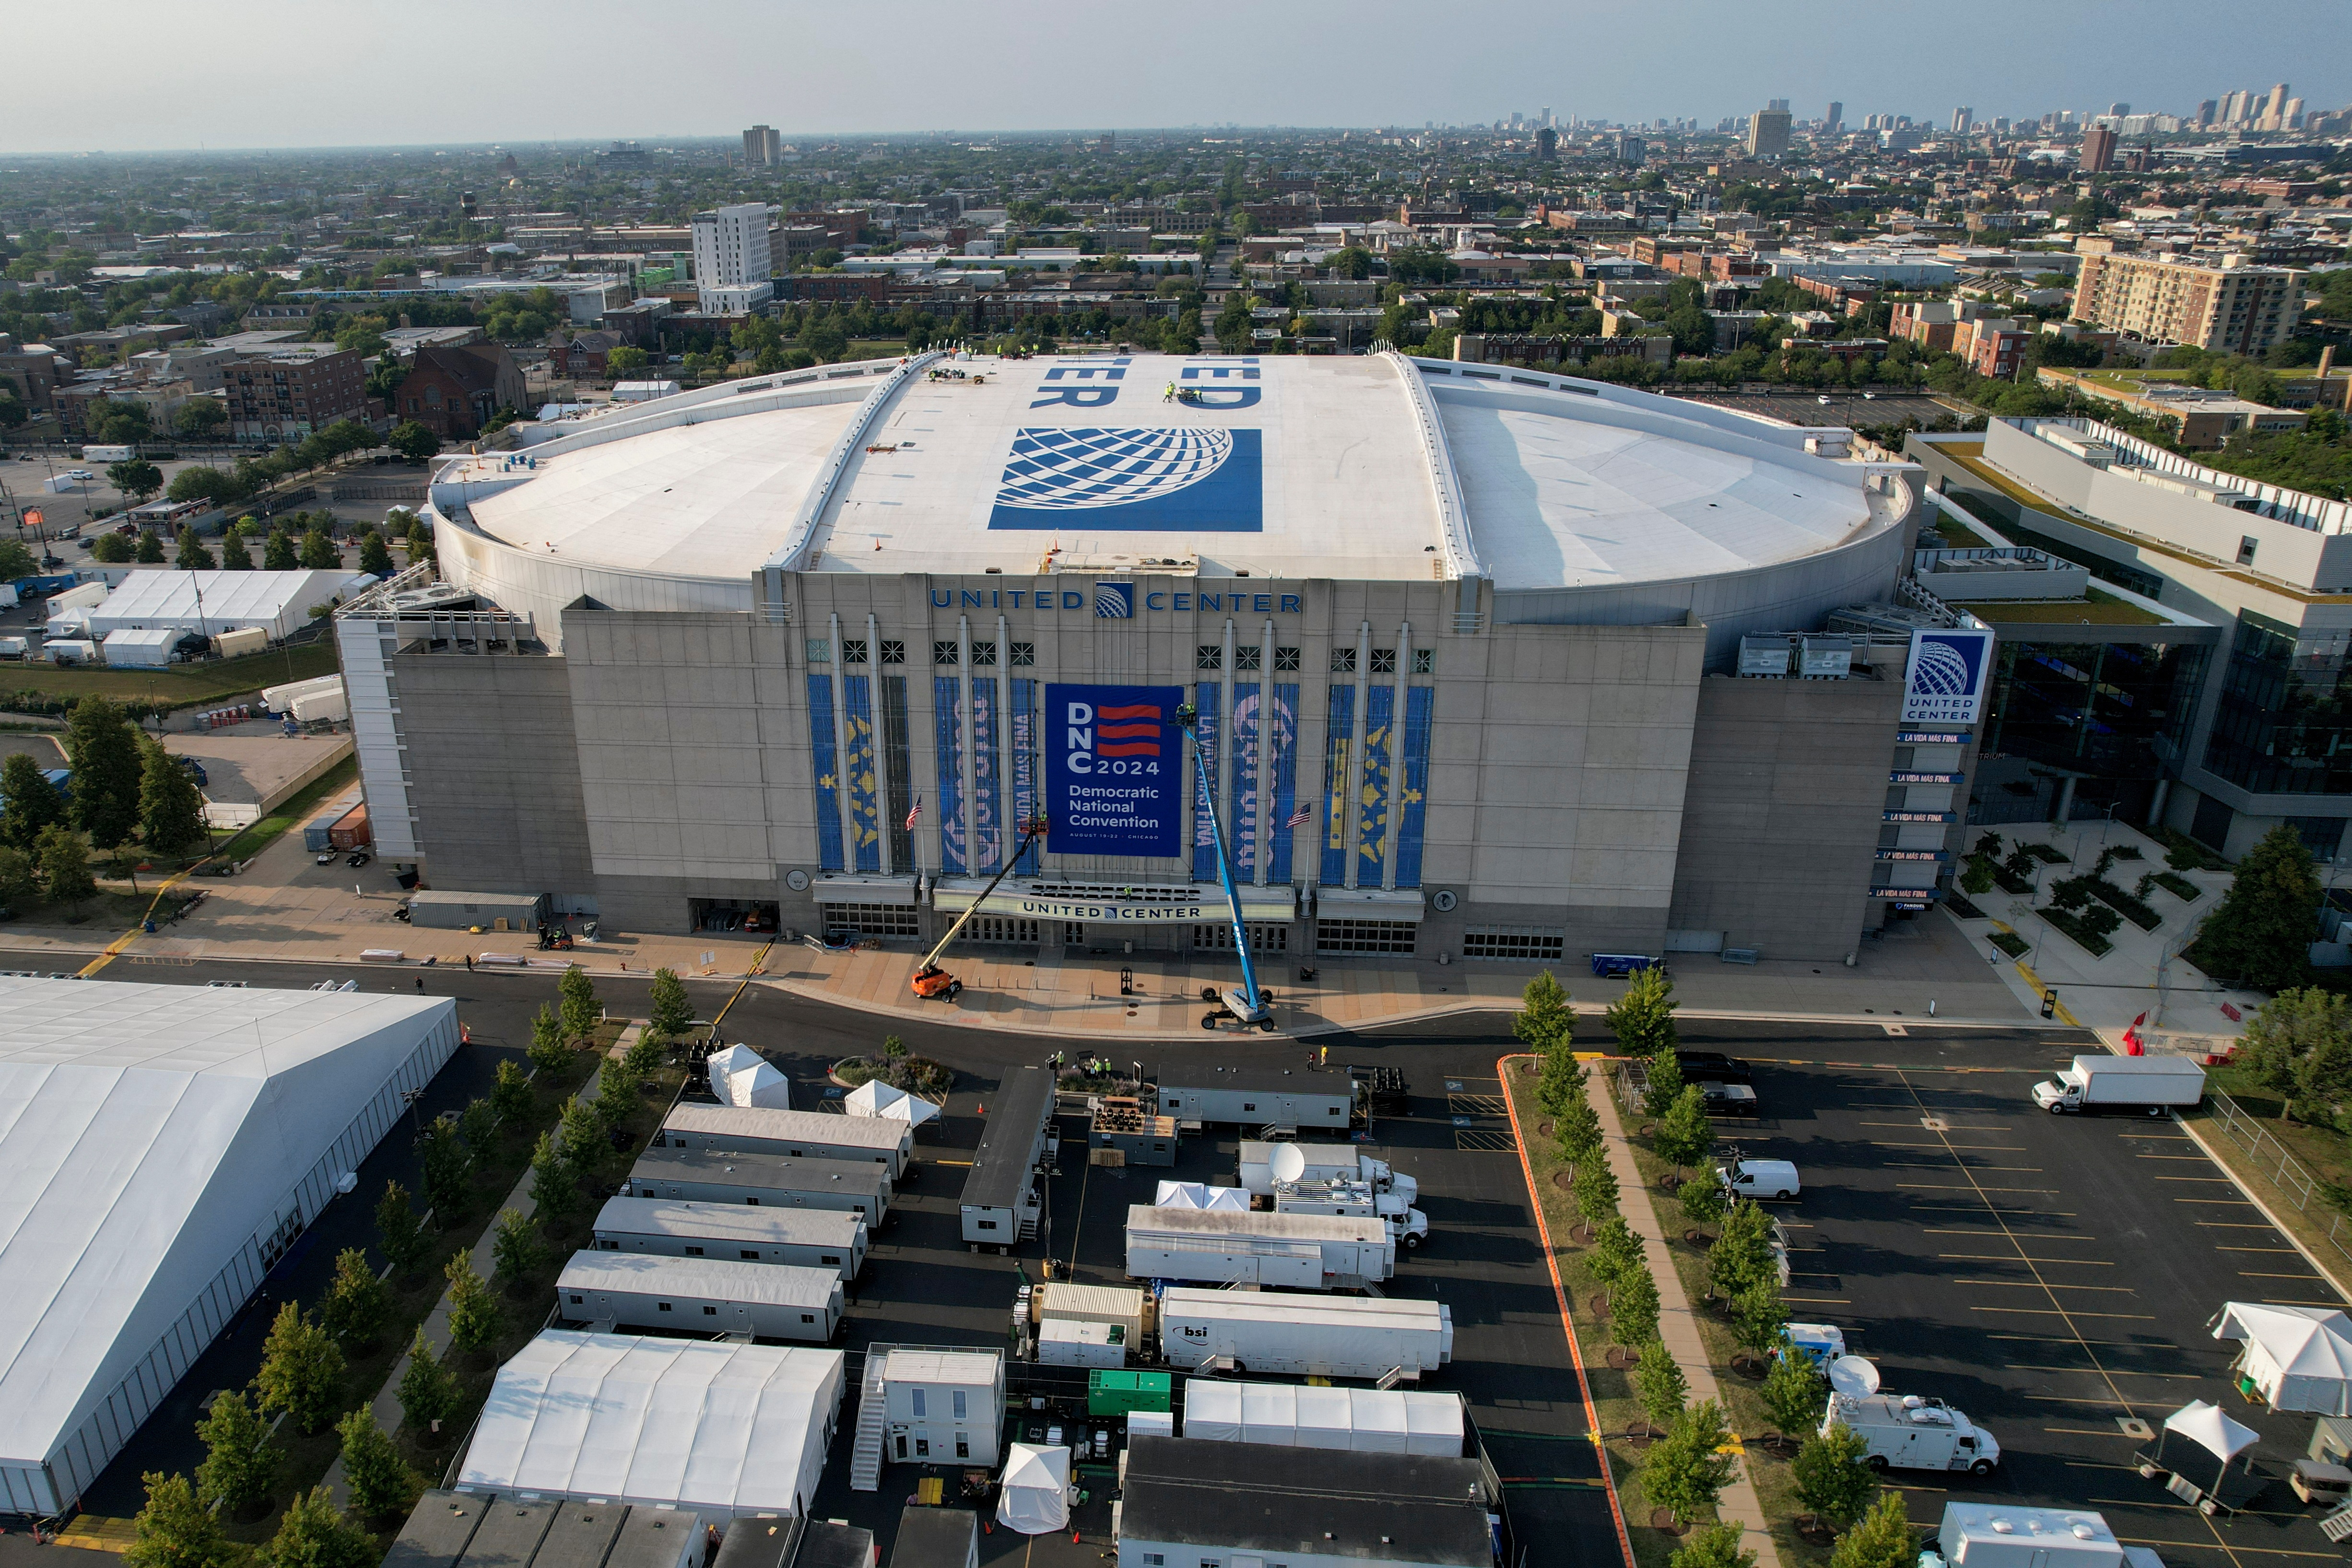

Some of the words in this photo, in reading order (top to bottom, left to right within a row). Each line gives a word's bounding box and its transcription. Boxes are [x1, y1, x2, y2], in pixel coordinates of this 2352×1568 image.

[931, 589, 1084, 610] UNITED
[1146, 592, 1302, 613] CENTER
[1908, 699, 1973, 708] UNITED
[1907, 710, 1970, 720] CENTER
[1014, 714, 1034, 750] FINA
[1928, 734, 1940, 742] MÁS
[1097, 761, 1160, 776] 2024
[1921, 774, 1933, 782] MÁS
[1070, 785, 1159, 799] Democratic
[1070, 800, 1134, 813] National
[1070, 814, 1159, 829] Convention
[1023, 902, 1101, 918] UNITED
[1122, 908, 1200, 919] CENTER
[1185, 1326, 1208, 1337] bsi
